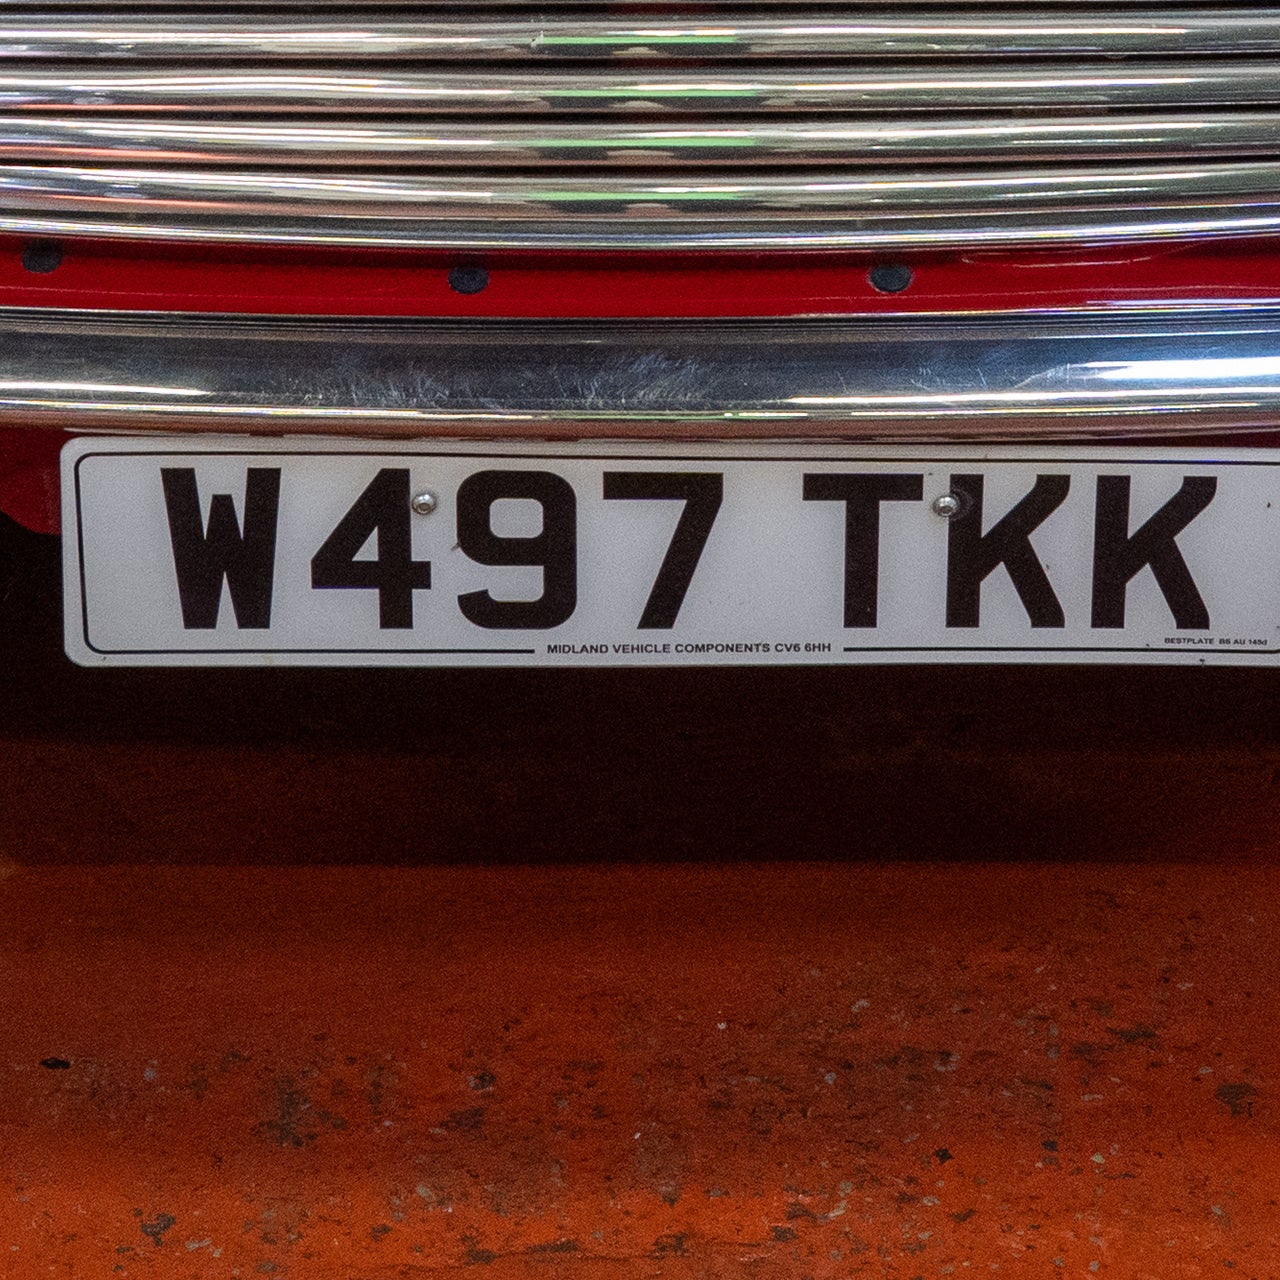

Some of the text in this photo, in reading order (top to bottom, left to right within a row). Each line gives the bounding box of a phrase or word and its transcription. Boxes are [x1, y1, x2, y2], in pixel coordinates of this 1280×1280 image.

[160, 467, 1218, 631] W497 TKK
[1163, 637, 1215, 646] BESTPLATE
[1233, 638, 1246, 646] AU
[546, 642, 832, 655] MIDLAND VEHICLE COMPONENTS CV6 6HH
